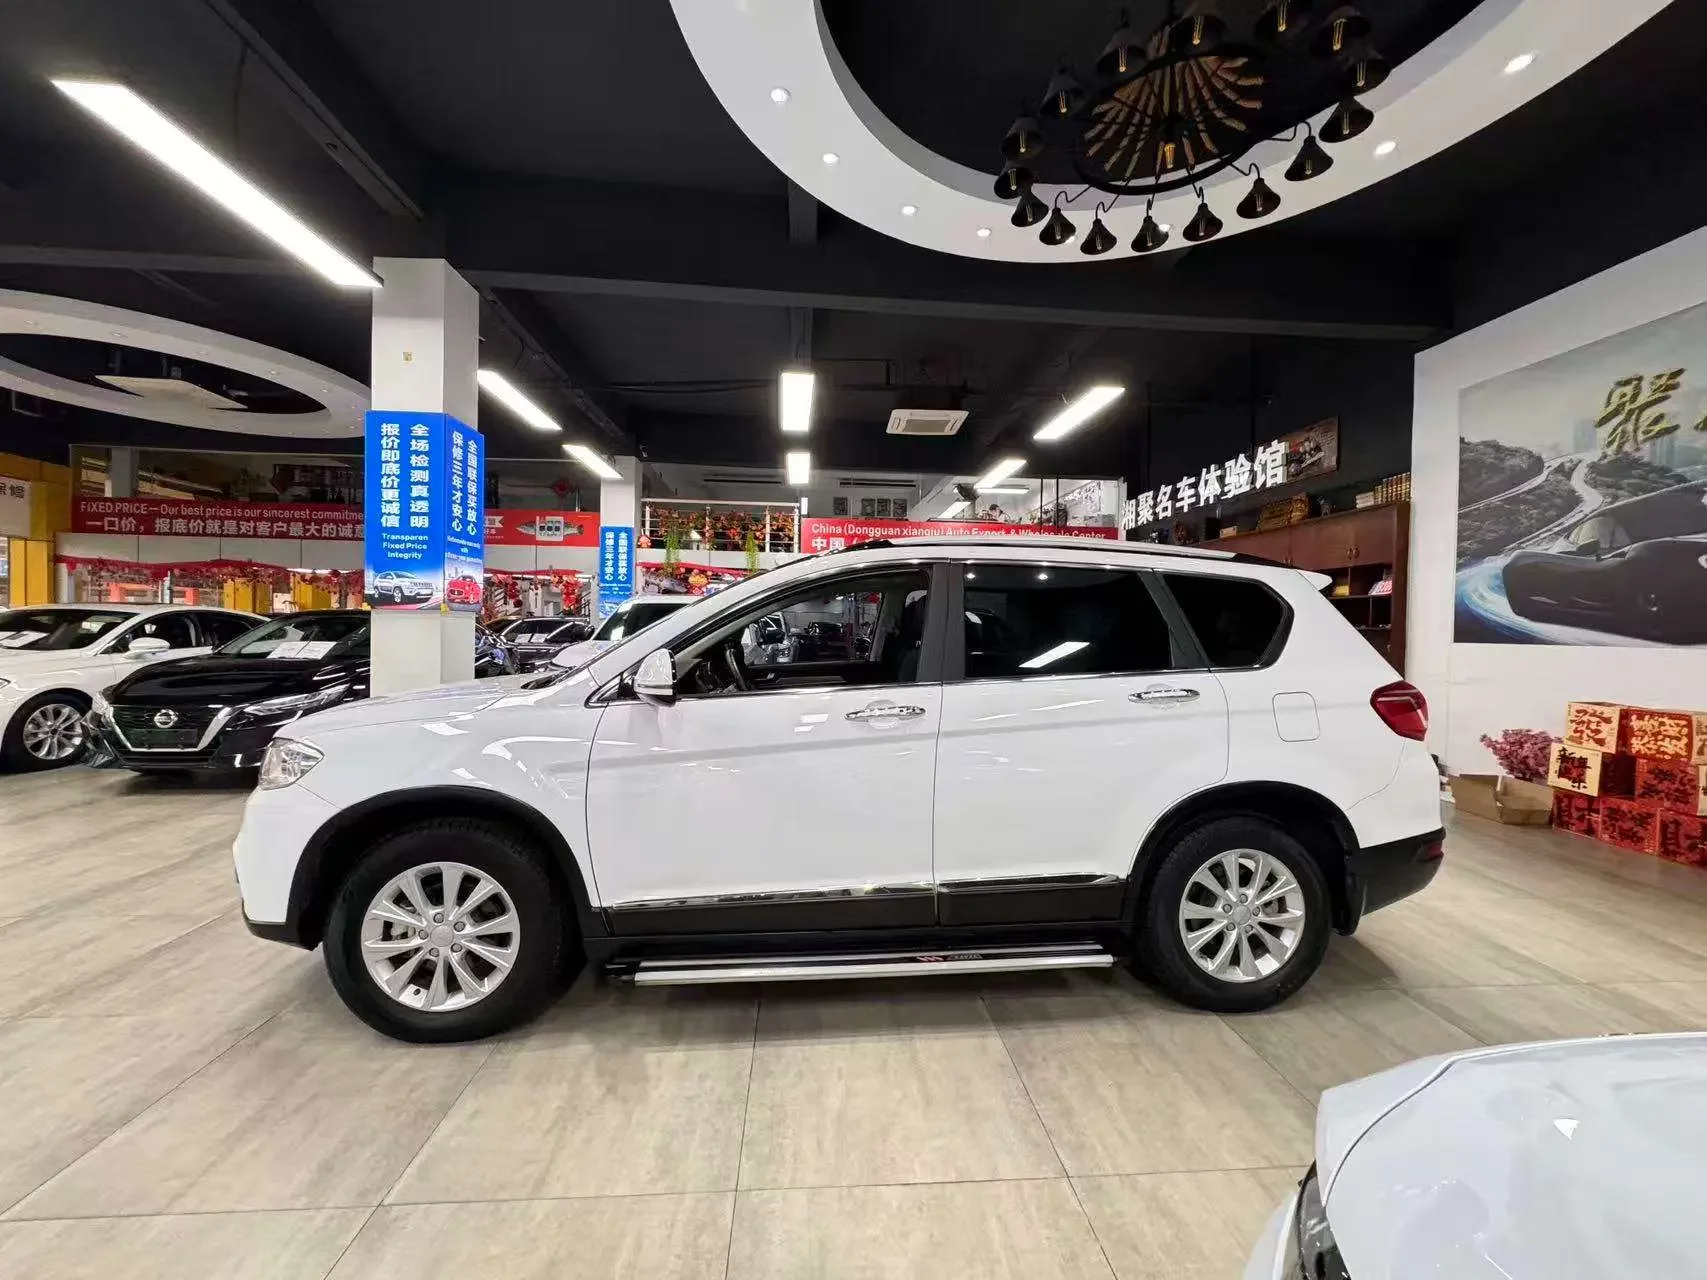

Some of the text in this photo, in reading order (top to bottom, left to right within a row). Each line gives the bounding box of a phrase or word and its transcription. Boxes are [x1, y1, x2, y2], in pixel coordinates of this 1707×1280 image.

[410, 423, 430, 528] 全场检测真透明
[1121, 439, 1287, 530] 湘聚名车体验馆
[80, 501, 112, 513] FIXED
[182, 504, 204, 517] best
[205, 506, 231, 521] price
[233, 507, 243, 518] is
[244, 509, 260, 518] our
[263, 508, 310, 519] sincerest
[382, 533, 429, 542] Transparen
[811, 523, 841, 533] China
[844, 523, 900, 537] (Dongguan
[387, 551, 422, 560] Integrity
